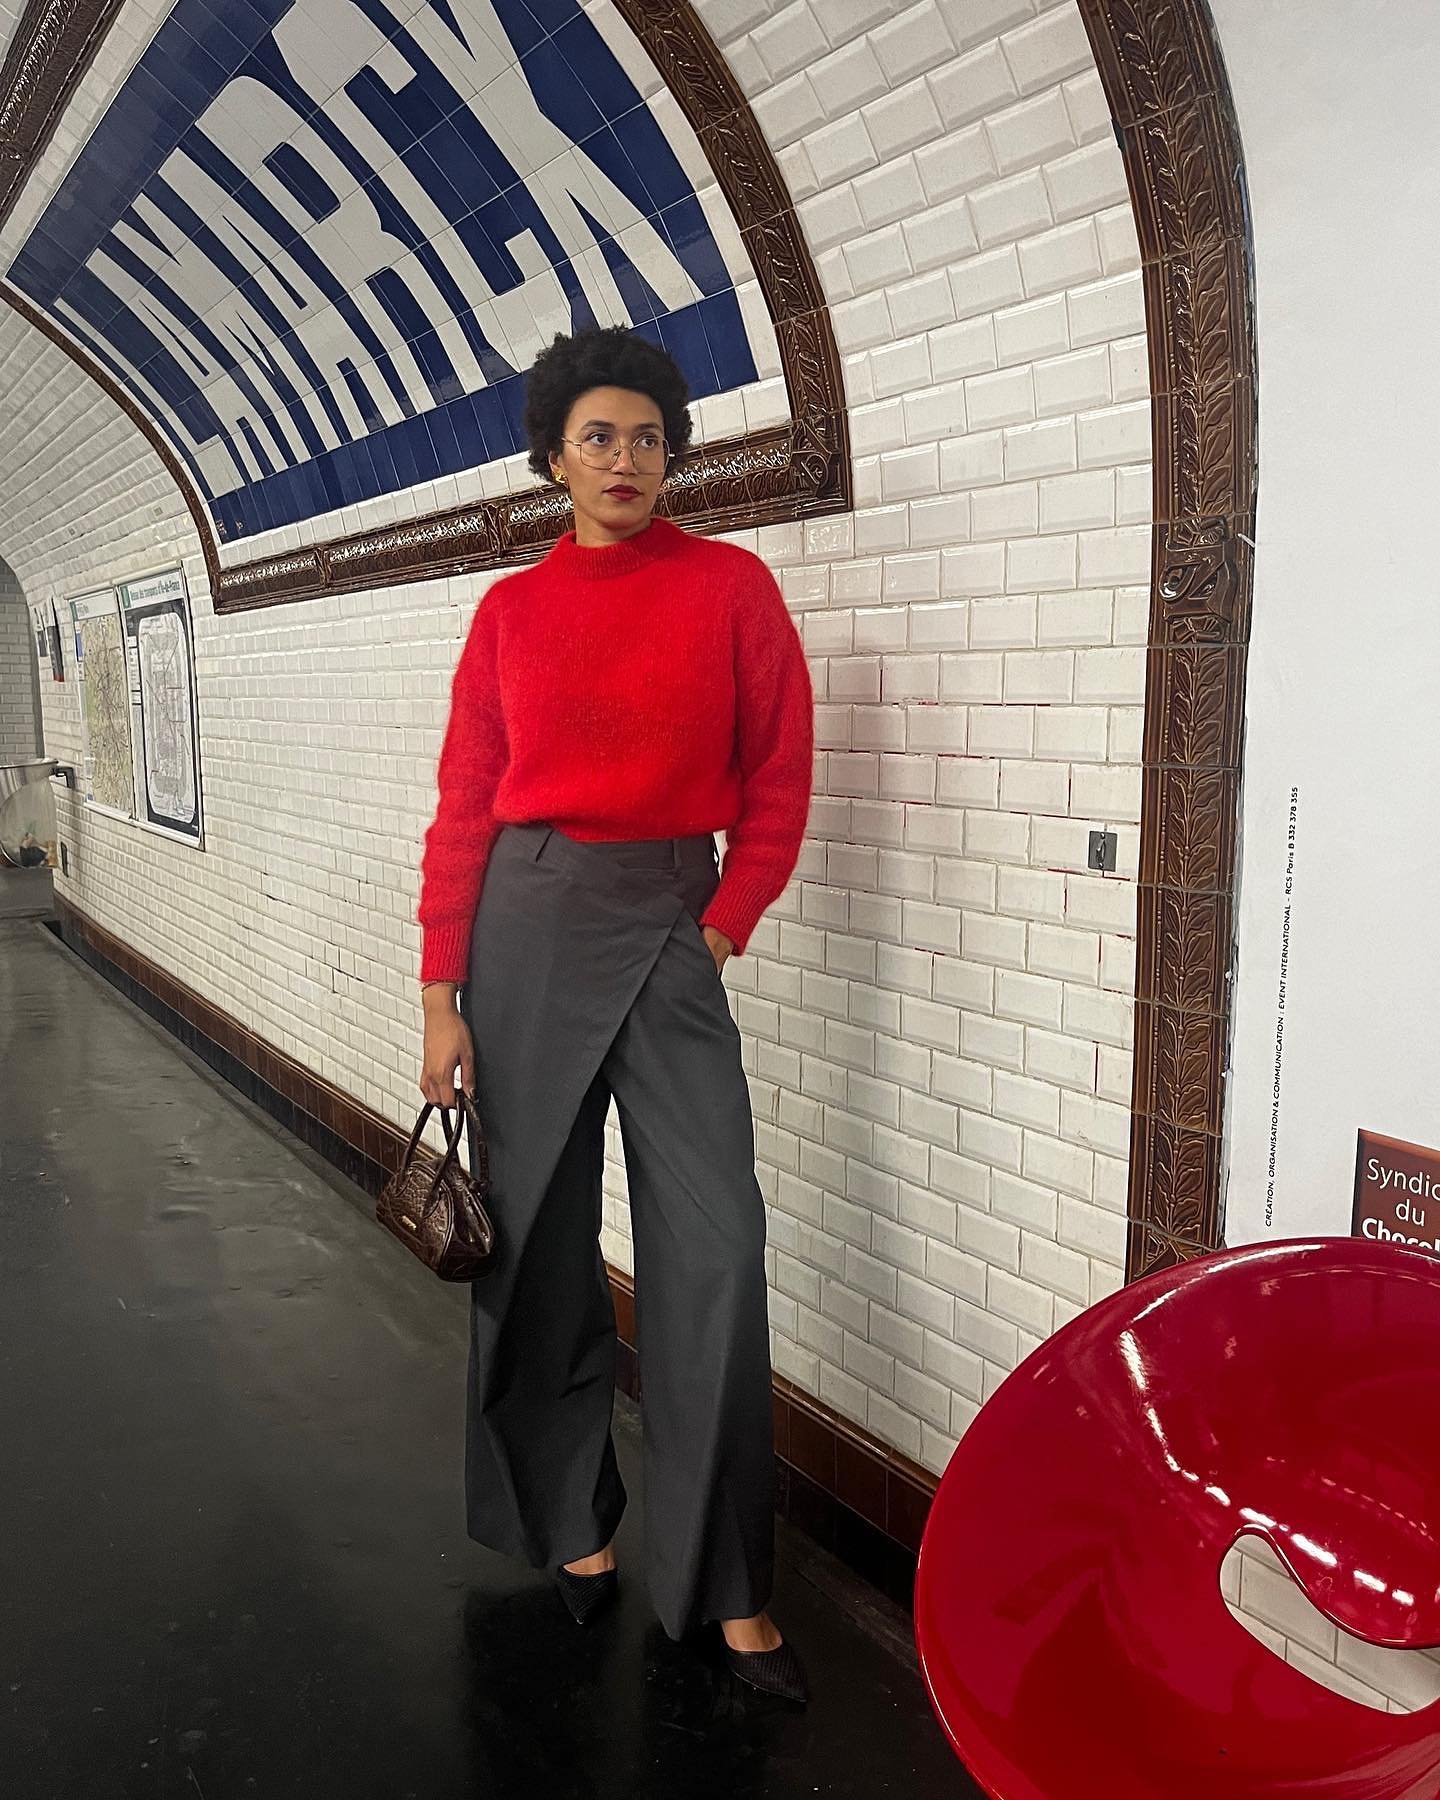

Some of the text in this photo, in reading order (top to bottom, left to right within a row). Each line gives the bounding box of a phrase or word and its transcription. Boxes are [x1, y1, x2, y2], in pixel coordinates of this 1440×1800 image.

[54, 0, 706, 499] LAMARCK
[1288, 824, 1296, 841] 332
[1286, 852, 1294, 874] Paris
[1285, 876, 1293, 895] RCS
[1281, 905, 1290, 978] INTERNATIONAL
[1278, 980, 1287, 1010] EVENT
[1274, 1017, 1284, 1099] COMMUNICATION
[1268, 1109, 1279, 1178] ORGANISATION
[1395, 1198, 1425, 1227] du
